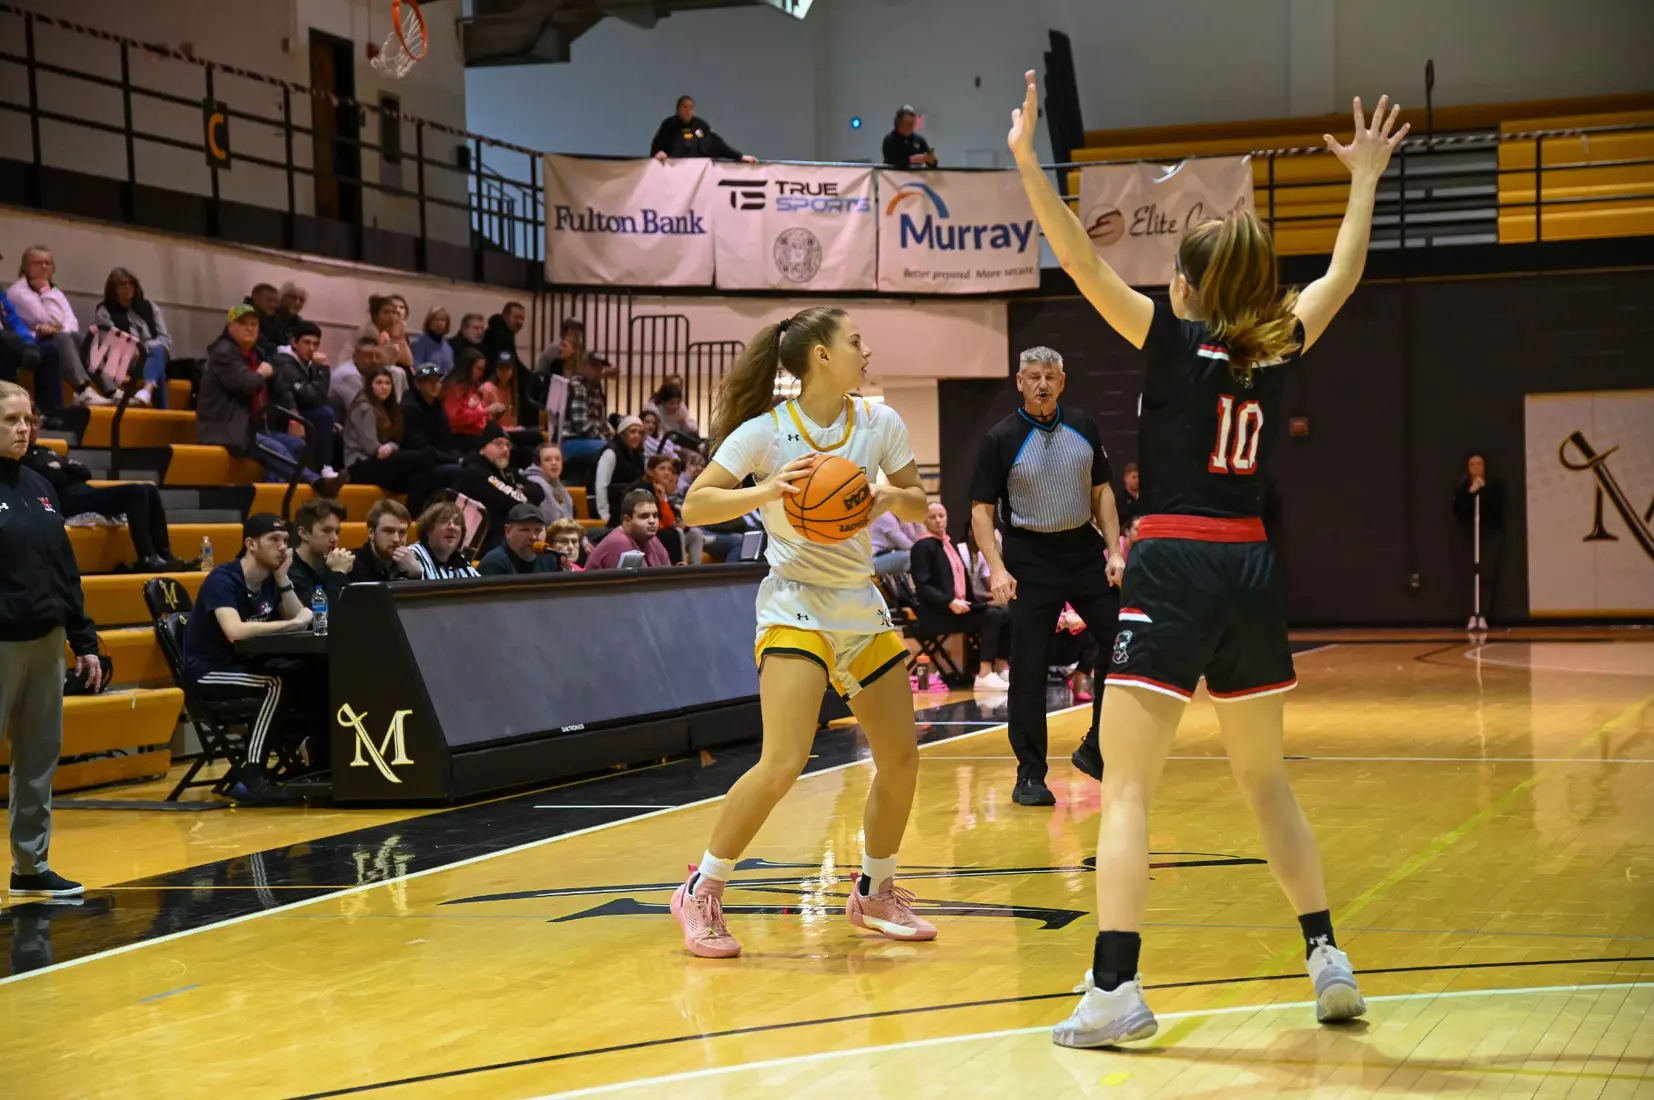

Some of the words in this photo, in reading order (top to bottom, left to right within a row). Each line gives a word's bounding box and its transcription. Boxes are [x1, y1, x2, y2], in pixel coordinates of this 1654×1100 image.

[208, 112, 226, 160] C
[775, 180, 838, 196] TRUE
[776, 196, 871, 213] SPORTS
[554, 205, 638, 235] Fulton
[640, 208, 707, 235] Bank
[900, 213, 1034, 253] Murray
[1129, 202, 1178, 237] Elite
[1208, 393, 1264, 475] 10
[337, 702, 415, 784] M
